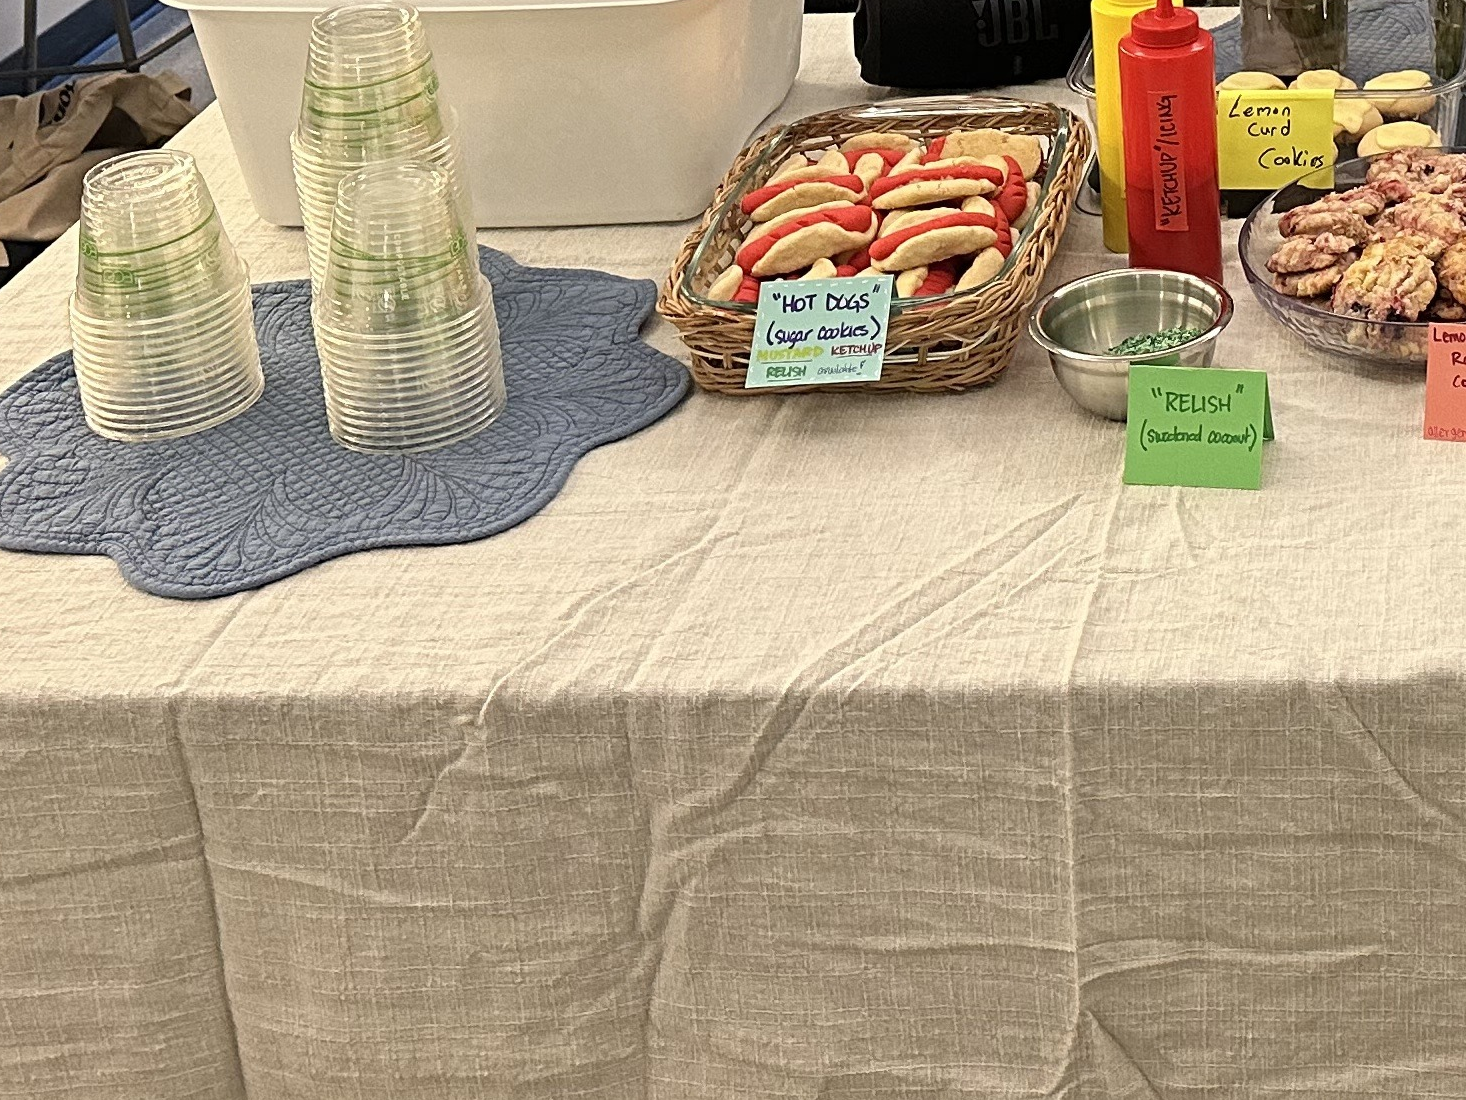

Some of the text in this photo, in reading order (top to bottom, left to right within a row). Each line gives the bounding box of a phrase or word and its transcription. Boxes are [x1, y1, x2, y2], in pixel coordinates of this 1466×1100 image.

[1229, 94, 1291, 118] Lemon
[1247, 119, 1291, 137] Curd
[1258, 146, 1324, 169] Cookies
[756, 342, 883, 360] MUSTARD KETCHUP
[766, 365, 807, 379] RELISH
